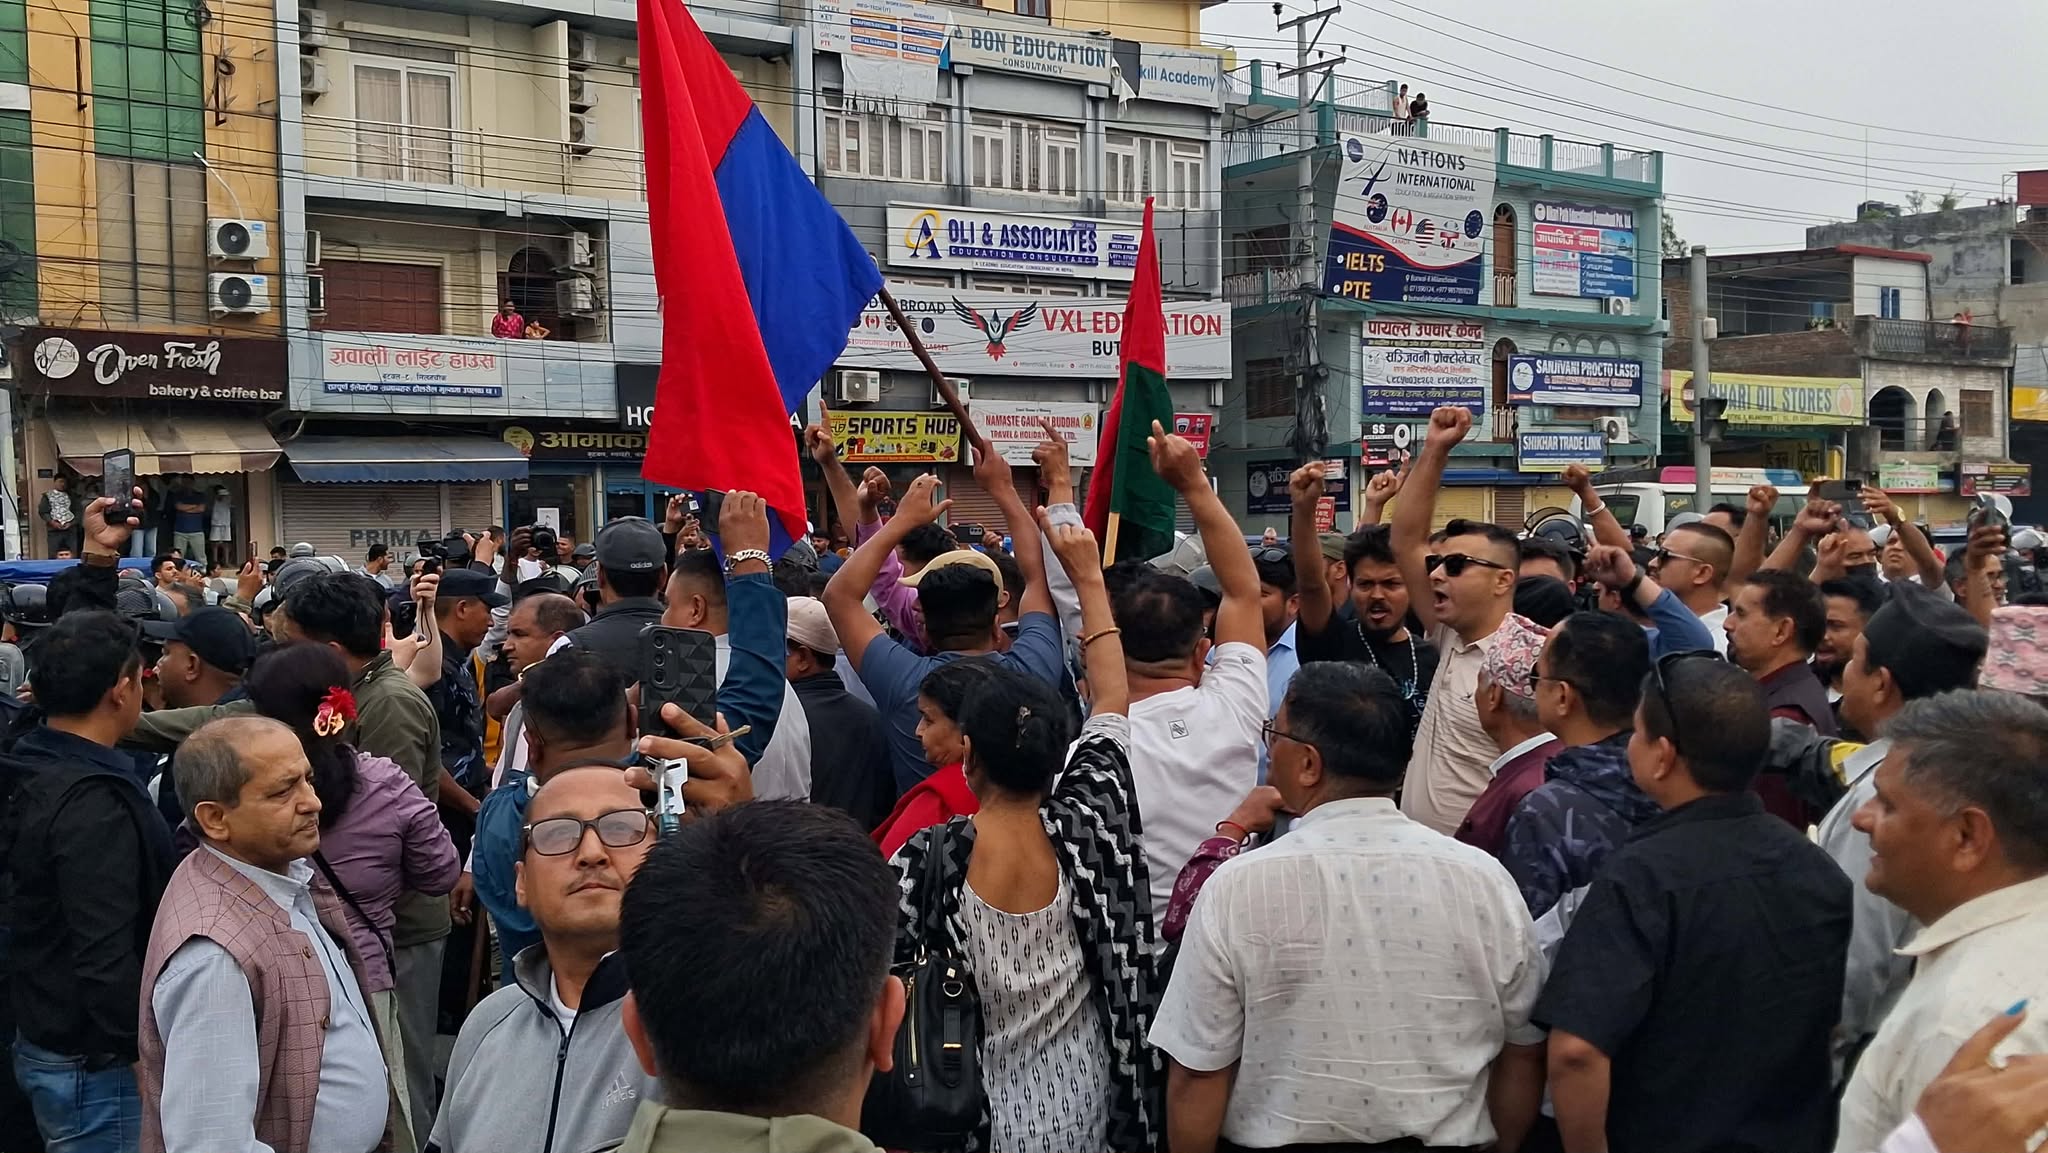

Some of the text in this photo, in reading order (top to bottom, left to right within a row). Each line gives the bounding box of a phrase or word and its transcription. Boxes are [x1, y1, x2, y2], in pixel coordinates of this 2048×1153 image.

[971, 28, 1106, 69] BON EDUCATION
[1002, 57, 1063, 74] CONSULTANCY
[1160, 67, 1217, 93] Academy
[1398, 148, 1466, 172] NATIONS
[1396, 171, 1476, 193] INTERNATIONAL
[948, 218, 1098, 255] OLI & ASSOCIATES
[951, 246, 1015, 259] EDUCATION
[1022, 251, 1097, 264] CONSULTANCY
[1345, 252, 1386, 273] IELTS
[1342, 280, 1372, 300] PTE
[1041, 307, 1222, 336] VXL EDTION
[1416, 322, 1453, 338] उपचार
[87, 340, 221, 385] Oven Fresh
[1536, 359, 1640, 379] SANJIVANI PROCTO LASER
[148, 384, 283, 401] bakery & coffee bar
[1756, 385, 1777, 411] OIL
[1782, 387, 1832, 413] STORES
[847, 417, 918, 436] SPORTS
[924, 418, 958, 436] HUB
[985, 415, 1020, 429] NAMASTE
[1051, 417, 1081, 428] BUDDHA
[1372, 424, 1386, 434] SS
[990, 430, 1013, 439] TRAVEL
[1013, 431, 1019, 439] &
[1019, 430, 1049, 439] HOLIDAYS
[1523, 435, 1602, 451] SHIKHAR TRADE LINK
[349, 528, 432, 548] PRIMA
[630, 561, 652, 569] adidas
[602, 1088, 636, 1110] ddas
